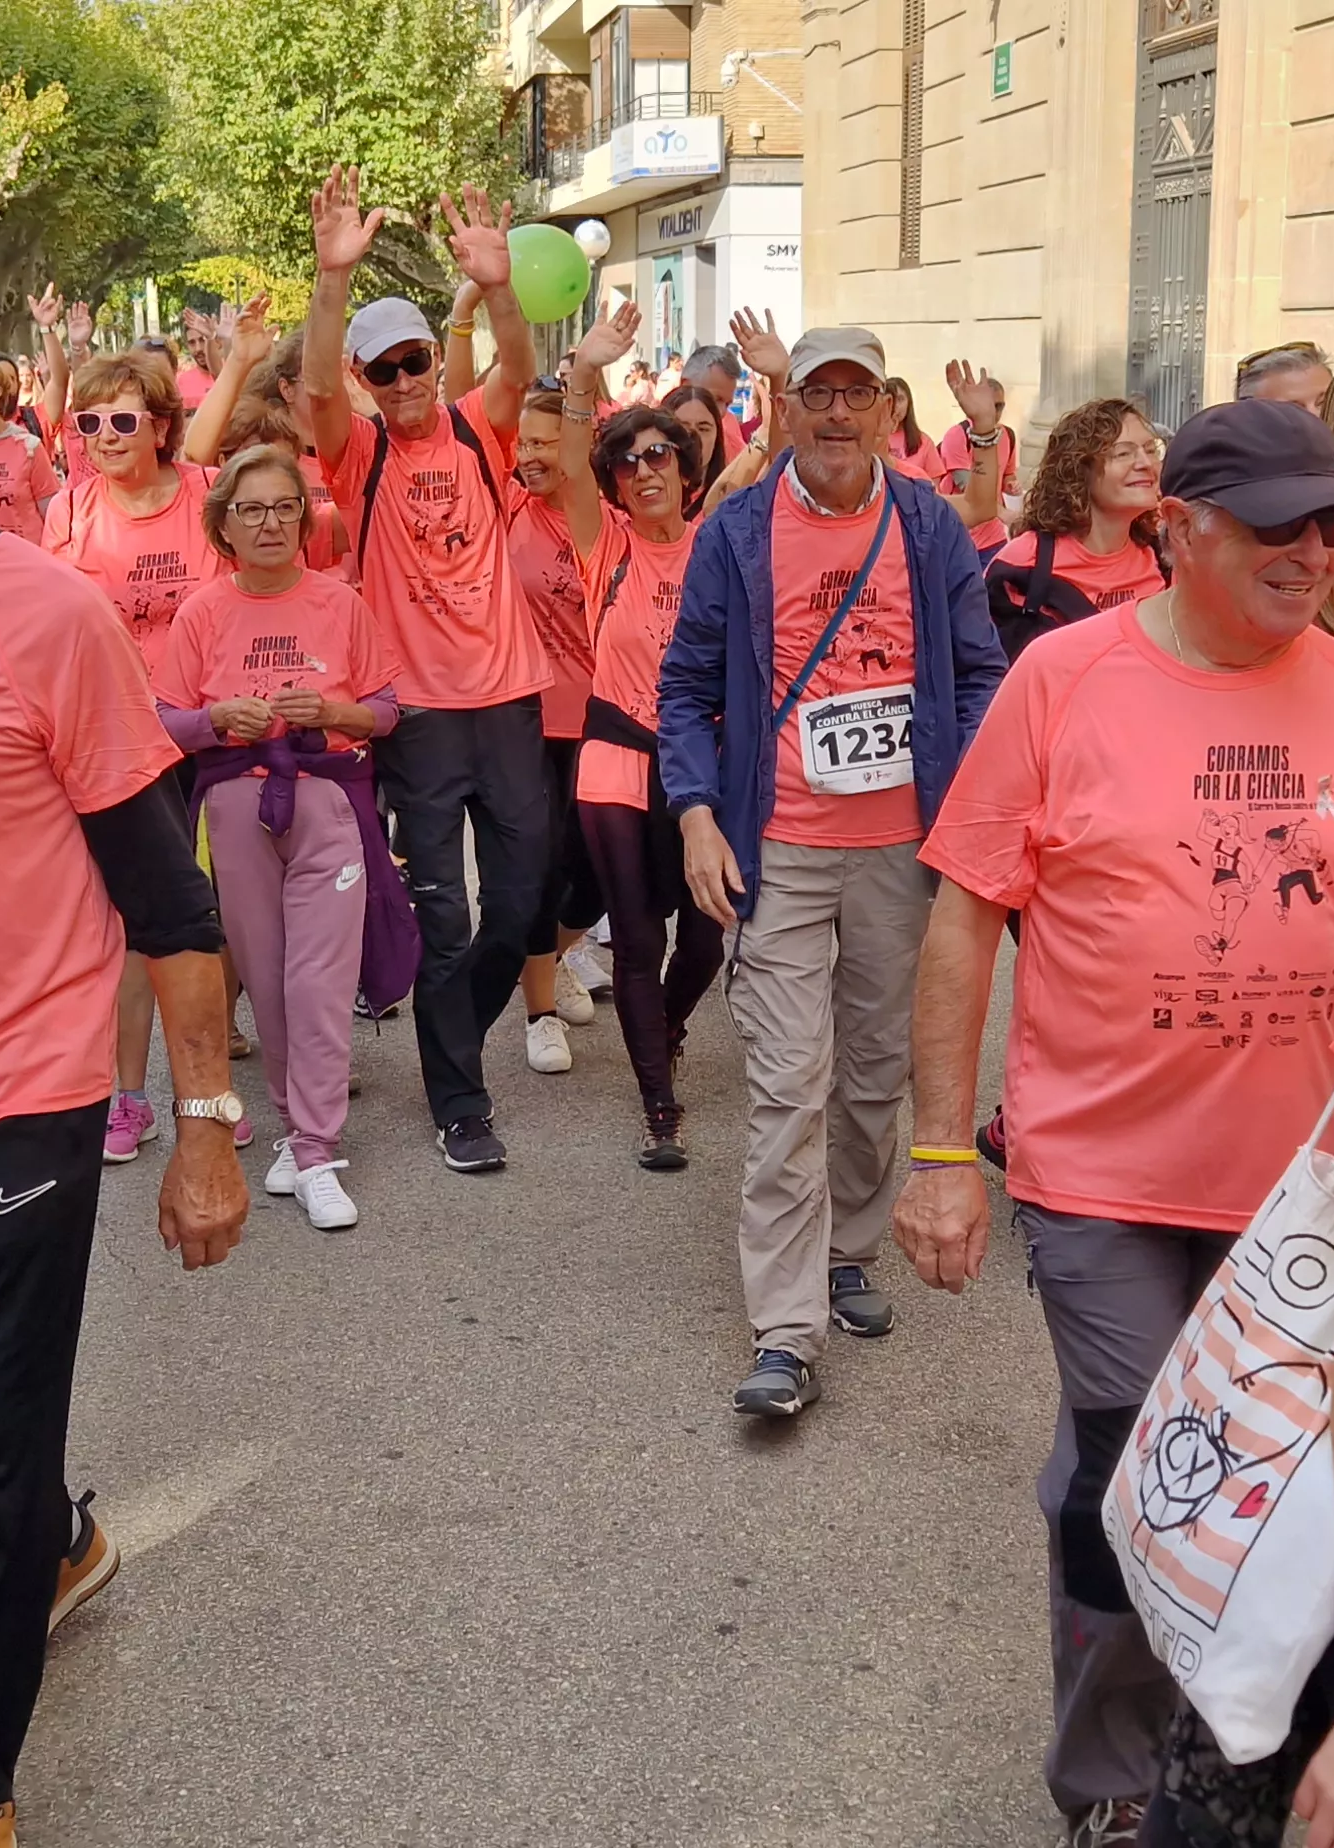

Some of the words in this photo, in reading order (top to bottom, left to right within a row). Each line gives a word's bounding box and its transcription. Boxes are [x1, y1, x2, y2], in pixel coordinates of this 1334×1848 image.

[658, 205, 703, 240] VITALDENT
[767, 244, 799, 256] SMY
[136, 551, 180, 569] CORRAMOS
[127, 568, 144, 582] POR
[144, 567, 153, 580] LA
[155, 563, 187, 580] CIENCIA
[809, 591, 829, 611] POR
[252, 635, 298, 653] CORRAMOS
[243, 653, 259, 670] POR
[260, 653, 269, 668] LA
[272, 652, 305, 667] CIENCIA
[850, 700, 883, 712] HUESCA
[816, 713, 862, 729] CONTRA
[862, 710, 876, 720] EL
[876, 703, 912, 717] CÁNCER
[817, 719, 914, 767] 1234
[1207, 745, 1290, 772] CORRAMOS
[1193, 774, 1221, 800] POR
[1225, 772, 1241, 801] LA
[1247, 773, 1306, 800] CIENCIA
